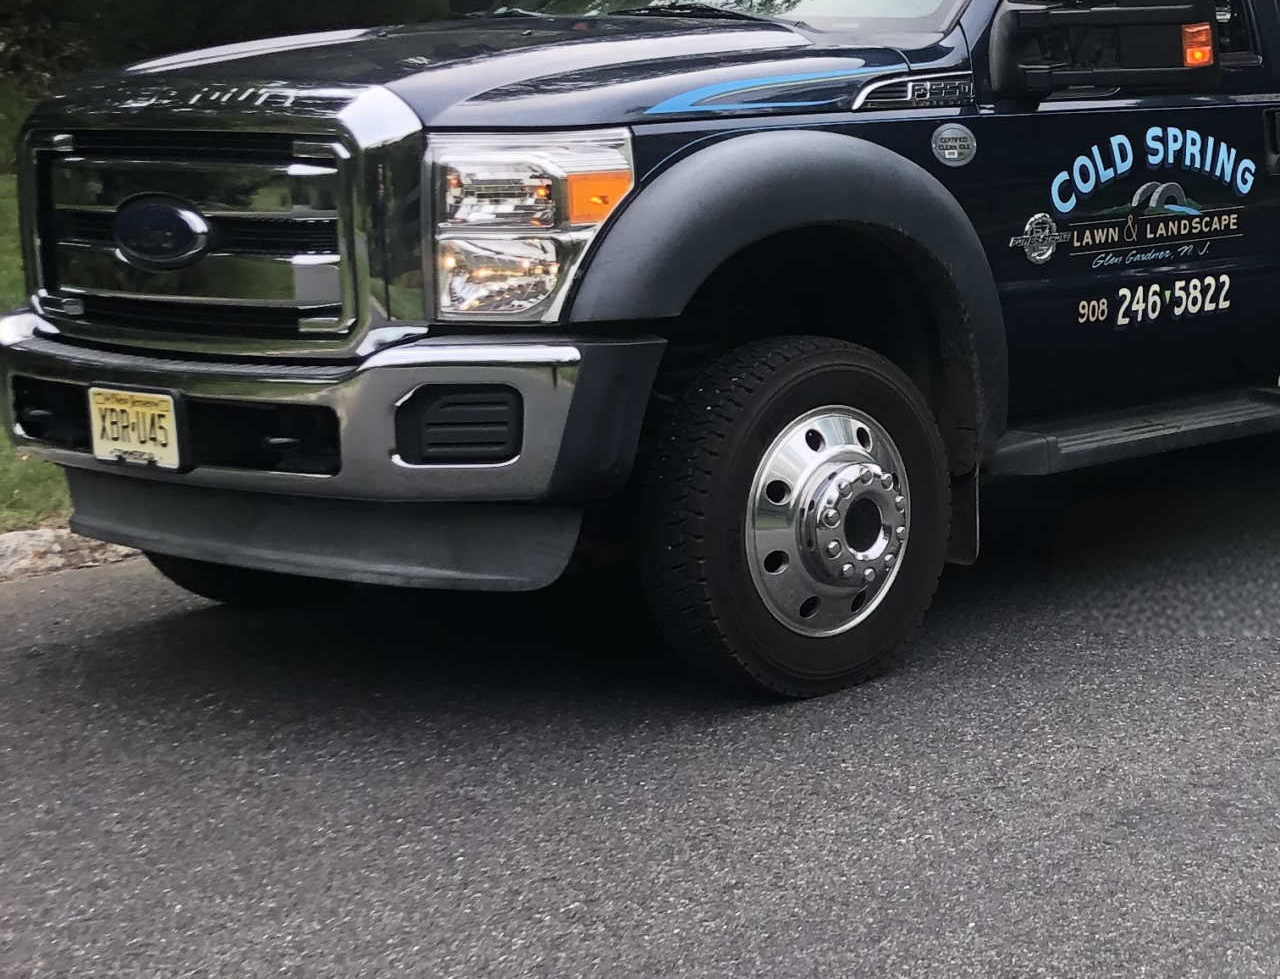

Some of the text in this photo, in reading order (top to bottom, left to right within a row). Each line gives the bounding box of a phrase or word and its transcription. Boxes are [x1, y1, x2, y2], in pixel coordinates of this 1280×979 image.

[1051, 126, 1256, 213] COLD SPRING
[1073, 214, 1238, 247] LAWN & LANDSCAPE
[1092, 254, 1123, 268] Glen
[1125, 249, 1174, 264] Gardner,
[1078, 298, 1108, 323] 908
